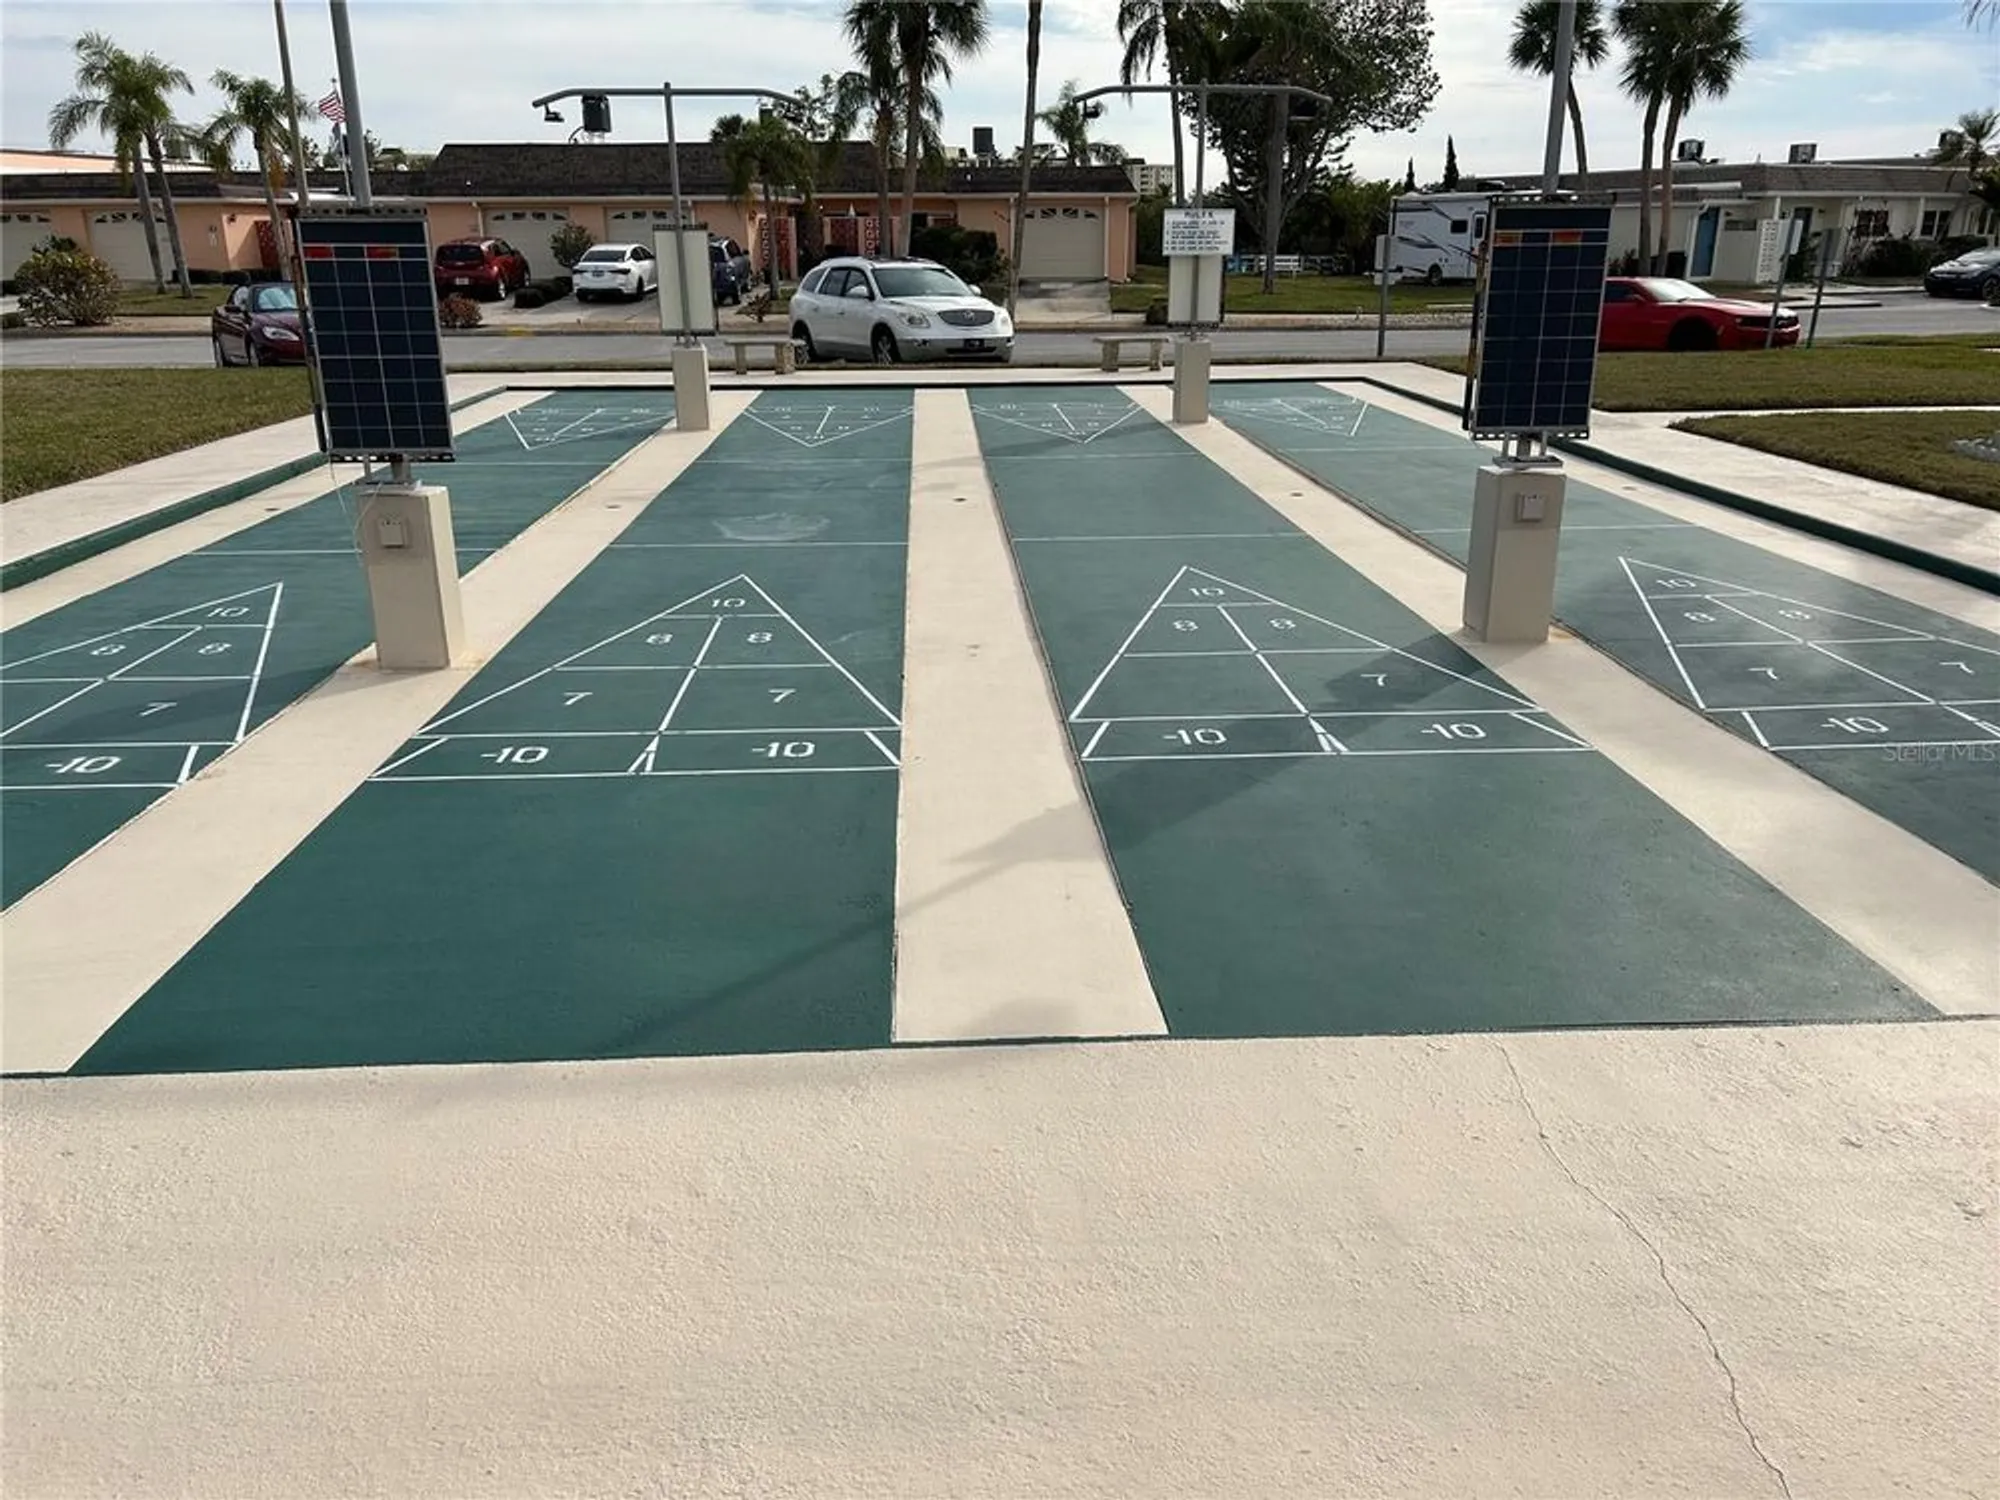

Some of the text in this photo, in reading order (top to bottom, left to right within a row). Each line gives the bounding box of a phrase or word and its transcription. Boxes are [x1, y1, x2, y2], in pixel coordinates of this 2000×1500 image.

[1656, 577, 1697, 589] 10
[1189, 586, 1226, 598] 10
[712, 598, 746, 608] 10
[207, 605, 250, 618] 10
[1748, 667, 1778, 680] 7
[1940, 661, 1974, 674] 7
[1360, 673, 1387, 687] 7
[562, 691, 593, 706] 7
[769, 688, 796, 704] 7
[139, 702, 177, 718] 7
[1421, 723, 1487, 739] -10
[1821, 716, 1889, 733] -10
[1163, 728, 1227, 745] -10
[480, 746, 549, 764] -10
[751, 741, 816, 758] -10
[45, 756, 122, 774] -10
